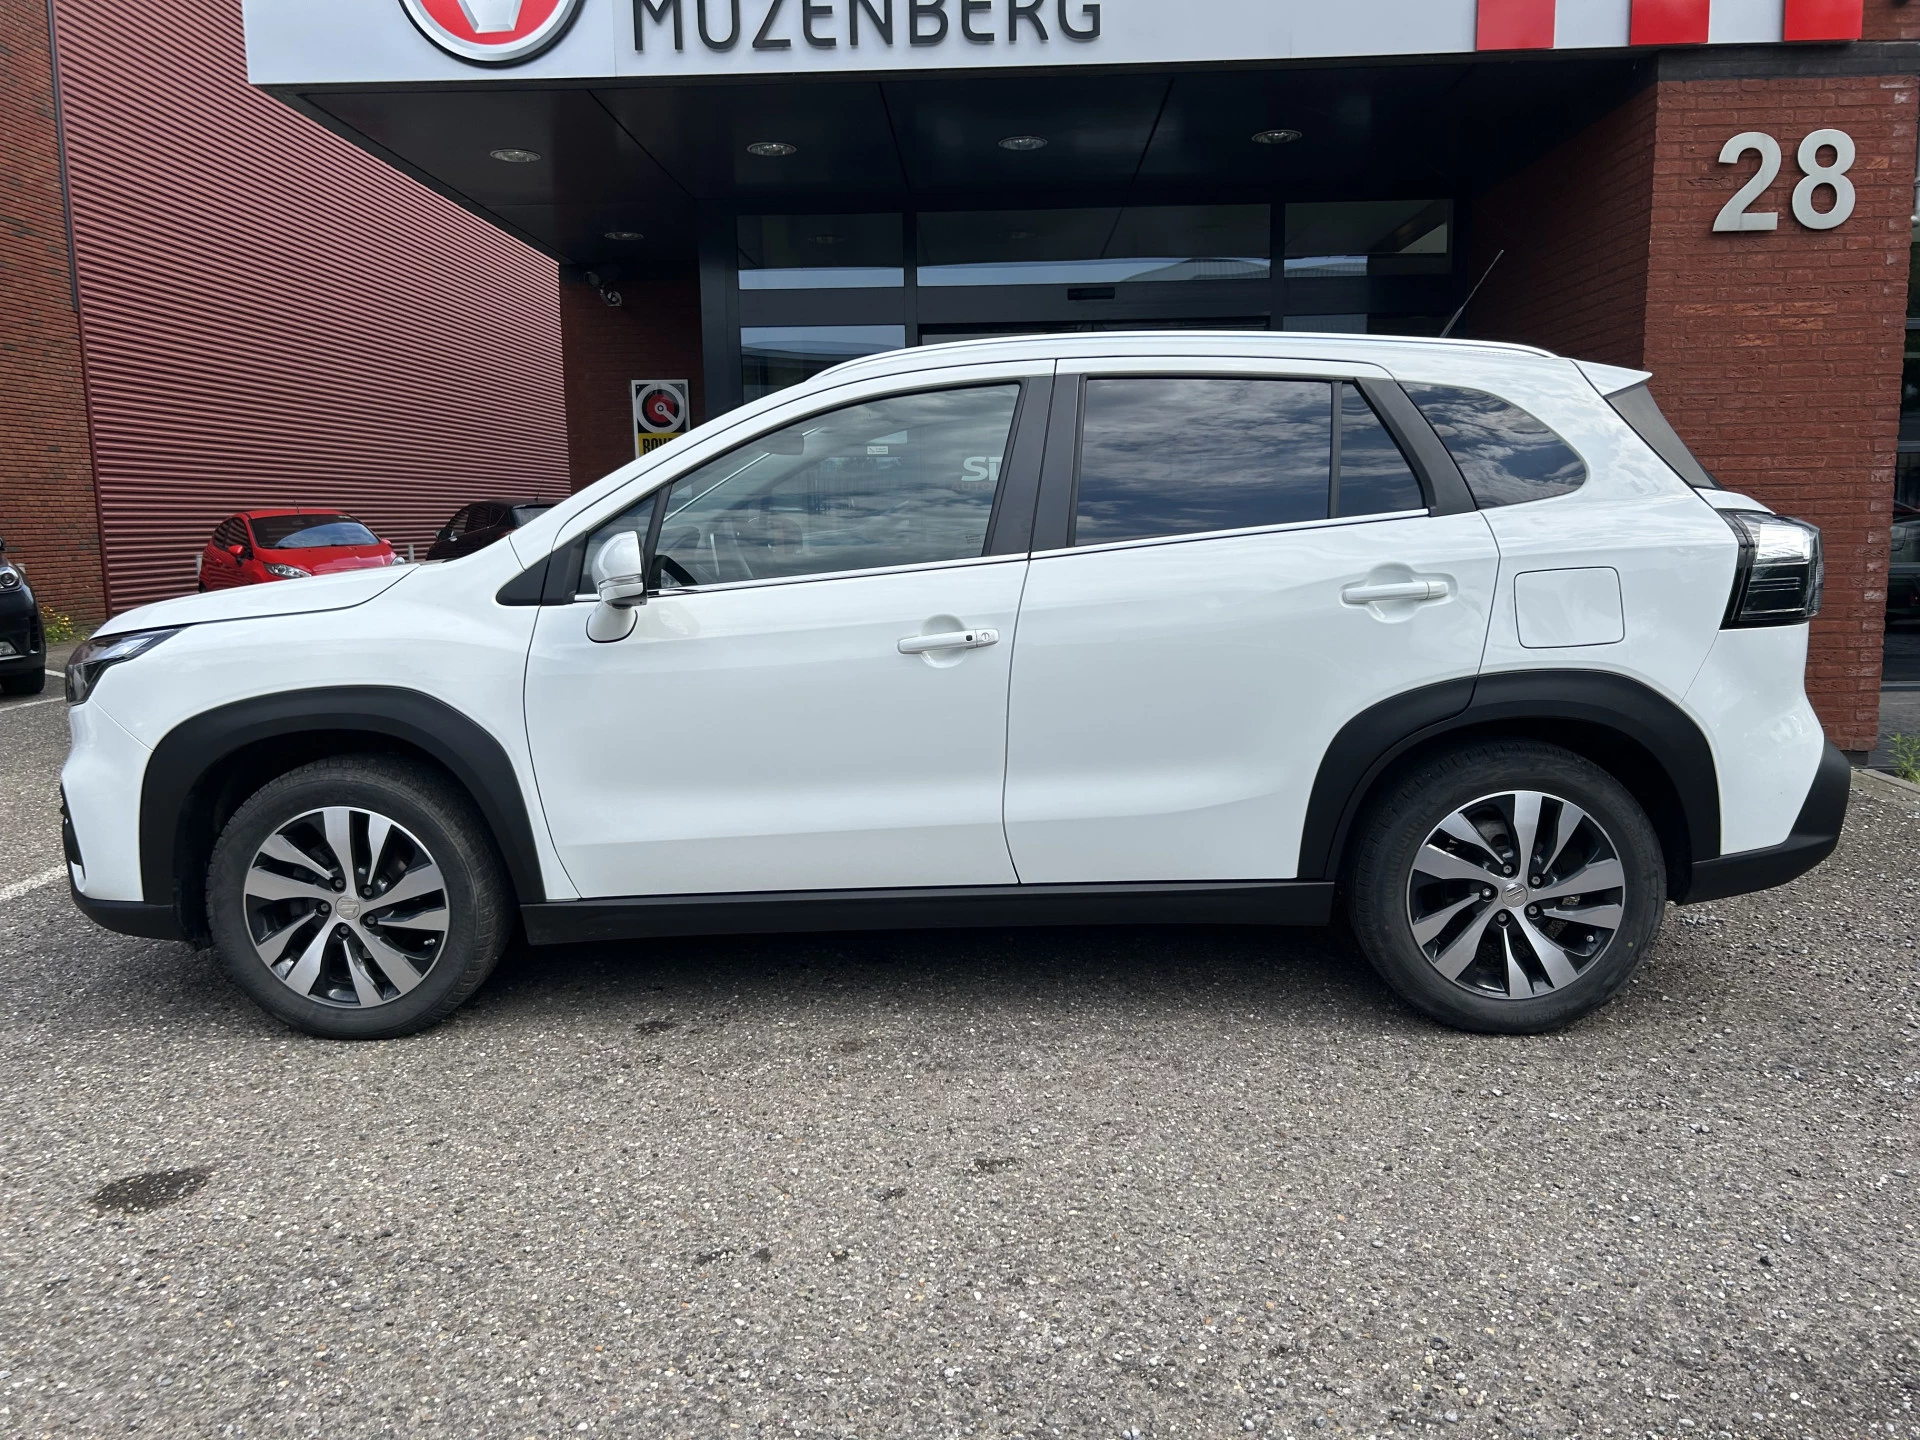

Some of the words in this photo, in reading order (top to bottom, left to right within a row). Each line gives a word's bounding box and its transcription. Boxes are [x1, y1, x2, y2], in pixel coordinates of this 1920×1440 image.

[632, 0, 1101, 53] MUZENBERG
[1712, 128, 1856, 232] 28
[642, 437, 673, 454] BO
[952, 482, 996, 491] AUTO
